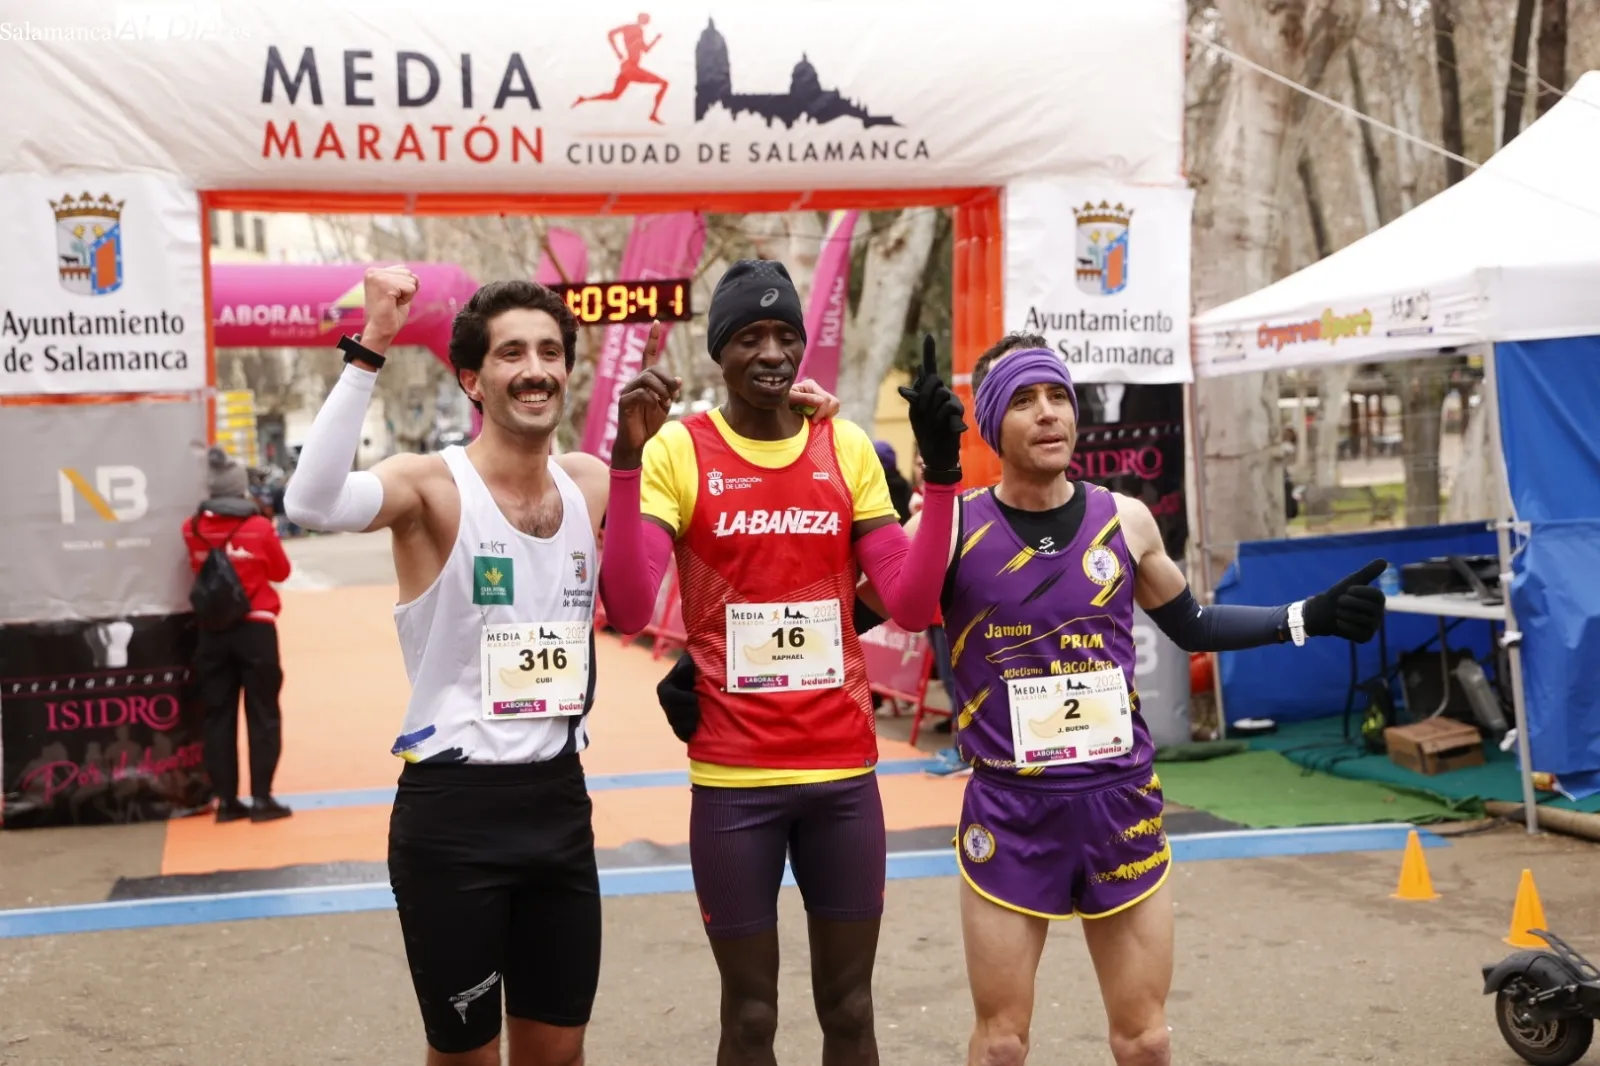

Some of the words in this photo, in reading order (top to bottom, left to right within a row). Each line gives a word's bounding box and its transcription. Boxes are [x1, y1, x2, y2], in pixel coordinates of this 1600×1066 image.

[260, 45, 542, 111] MEDIA
[261, 116, 544, 164] MARATÓN
[567, 142, 681, 165] CIUDAD
[699, 142, 730, 163] DE
[748, 139, 930, 162] SALAMANCA
[2, 309, 185, 343] Ayuntamiento
[1025, 305, 1173, 338] Ayuntamiento
[4, 347, 34, 374] de
[43, 345, 189, 373] Salamanca
[1057, 340, 1174, 366] Salamanca
[1066, 446, 1165, 480] SIDRO
[725, 476, 763, 484] DIPUTACIÓN
[732, 612, 764, 620] MEDIA
[487, 632, 521, 642] MEDIA
[772, 627, 805, 648] 16
[984, 621, 1032, 639] Jamón
[1060, 633, 1104, 650] PRIM
[519, 648, 567, 672] 316
[772, 653, 804, 661] RAPHAEL
[1014, 685, 1047, 696] MEDIA
[45, 694, 180, 731] ISIDRO
[1063, 698, 1081, 720] 2
[1065, 724, 1090, 733] BUENO
[1033, 749, 1063, 758] LABORAL
